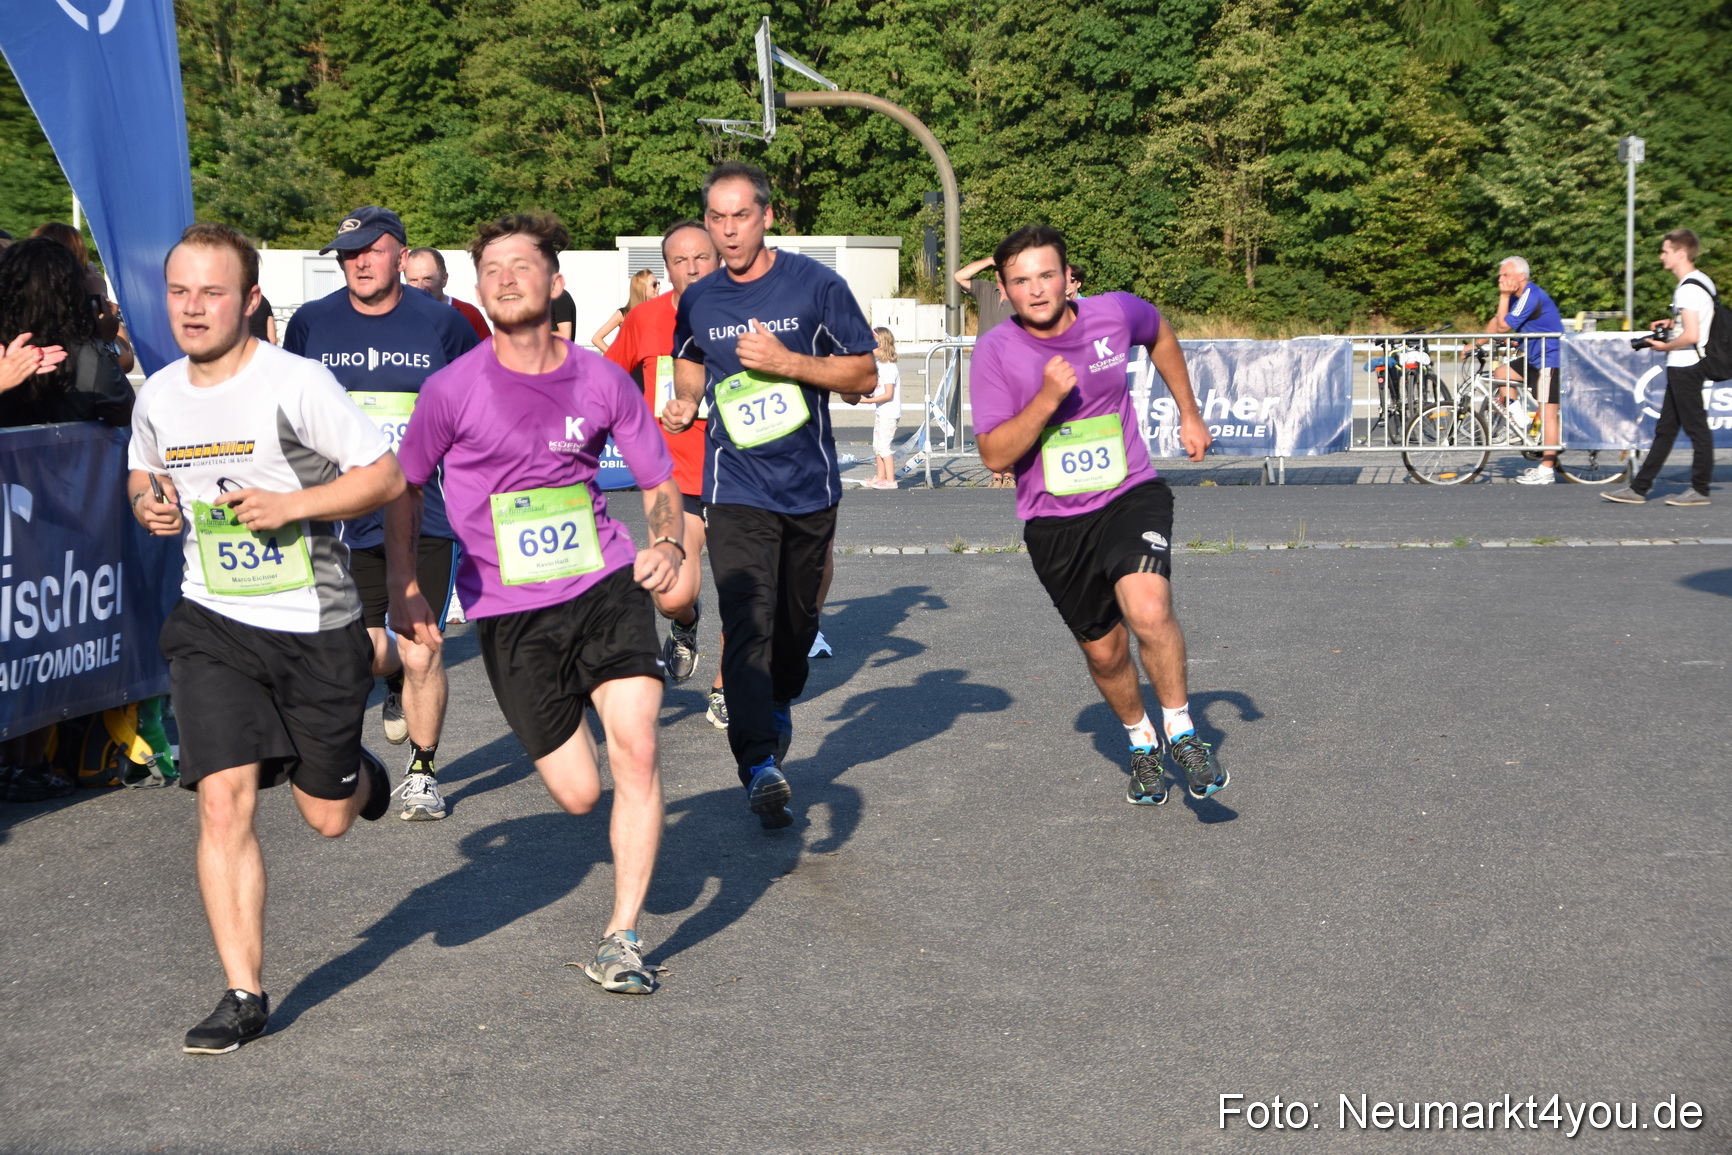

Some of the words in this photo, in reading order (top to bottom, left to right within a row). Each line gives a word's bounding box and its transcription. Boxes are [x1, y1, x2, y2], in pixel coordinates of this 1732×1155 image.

[709, 324, 747, 340] EURO
[1094, 336, 1114, 359] K
[321, 352, 365, 367] EURO
[382, 352, 430, 368] POLES
[738, 392, 787, 425] 373
[566, 416, 585, 440] K
[193, 459, 226, 467] KOMPETENZ
[1061, 446, 1111, 474] 693
[519, 521, 579, 557] 692
[218, 537, 284, 570] 534
[252, 573, 278, 582] Eichner
[0, 633, 121, 692] AUTOMOBILE
